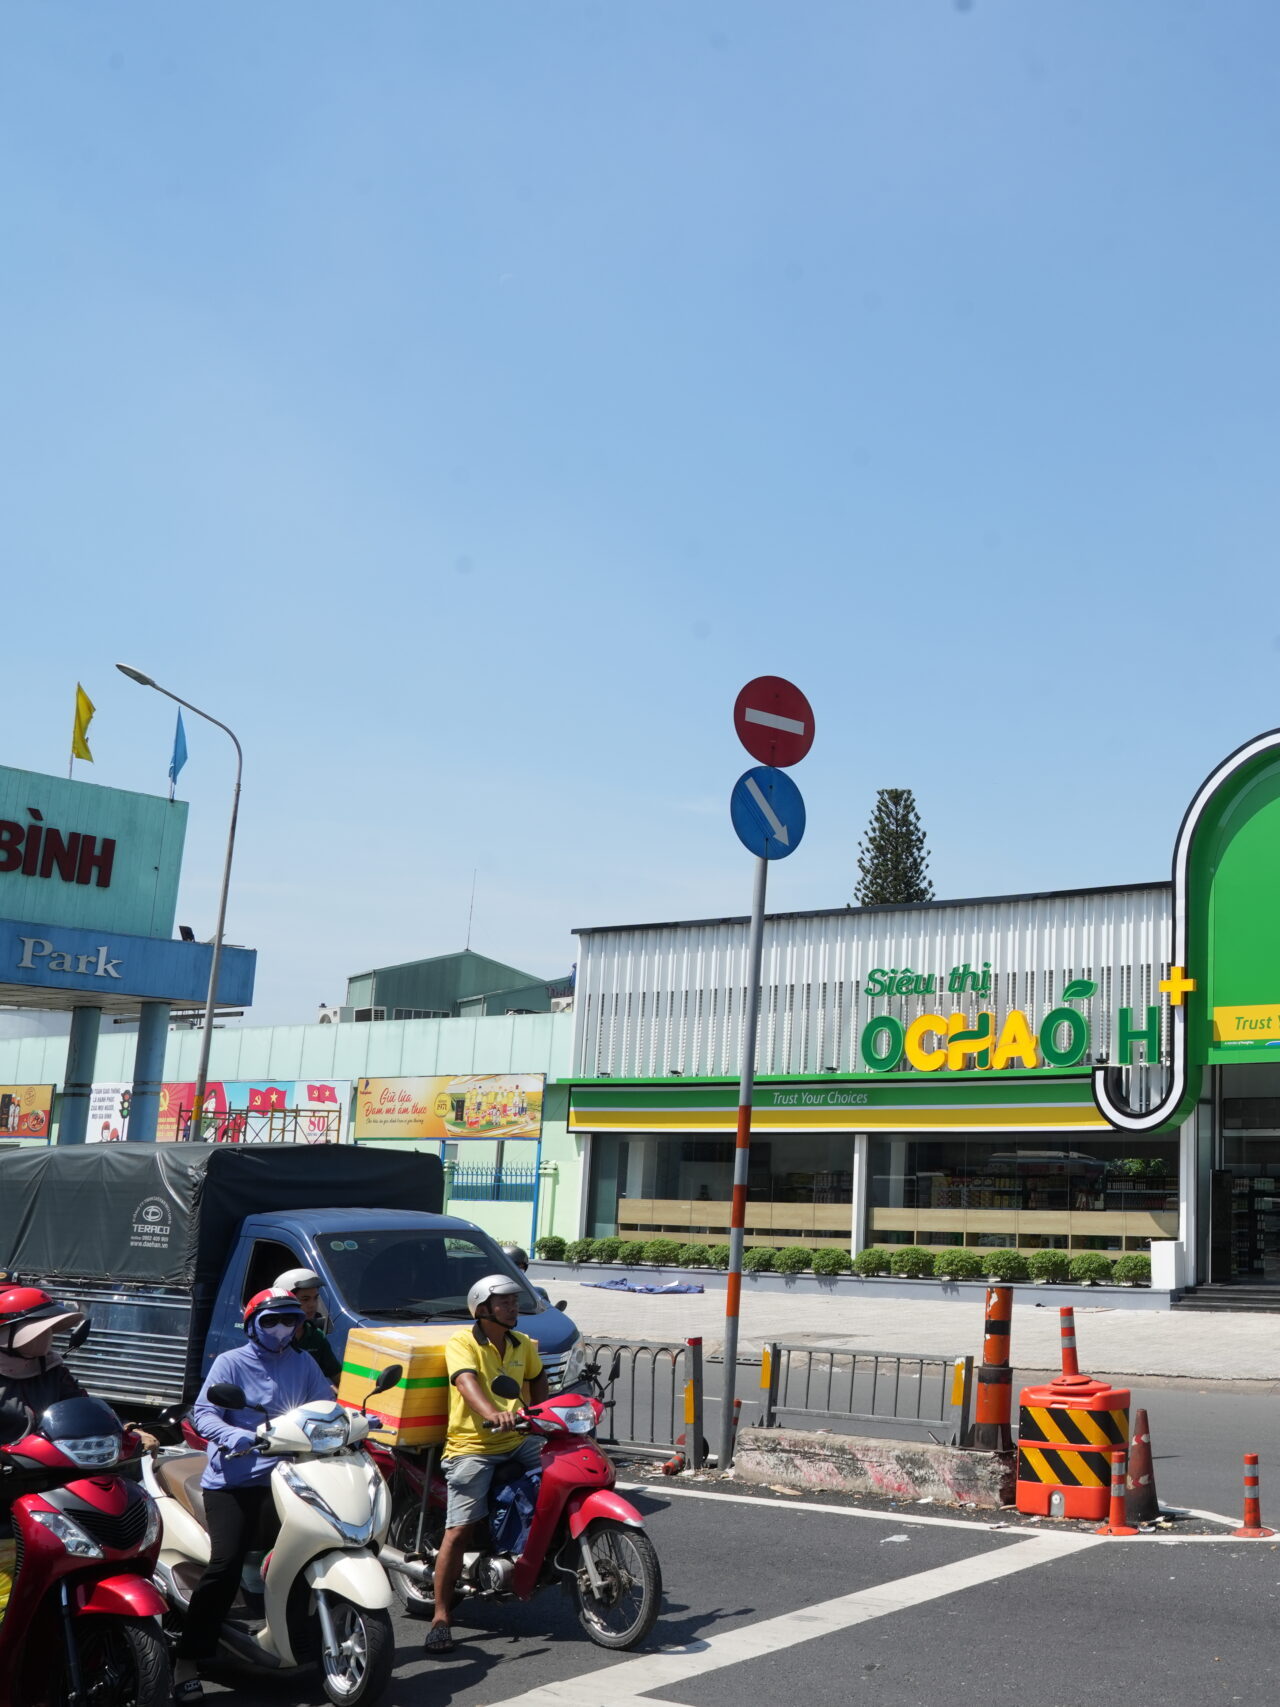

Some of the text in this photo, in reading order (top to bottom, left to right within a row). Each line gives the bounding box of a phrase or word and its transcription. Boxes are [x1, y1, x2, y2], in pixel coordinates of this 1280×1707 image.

[0, 807, 116, 888] BÌNH
[17, 936, 123, 979] Park
[864, 962, 993, 999] Siêu thị
[1235, 1015, 1273, 1031] Trust
[773, 1090, 868, 1104] Trust Your Choices
[132, 1224, 170, 1234] TERACO
